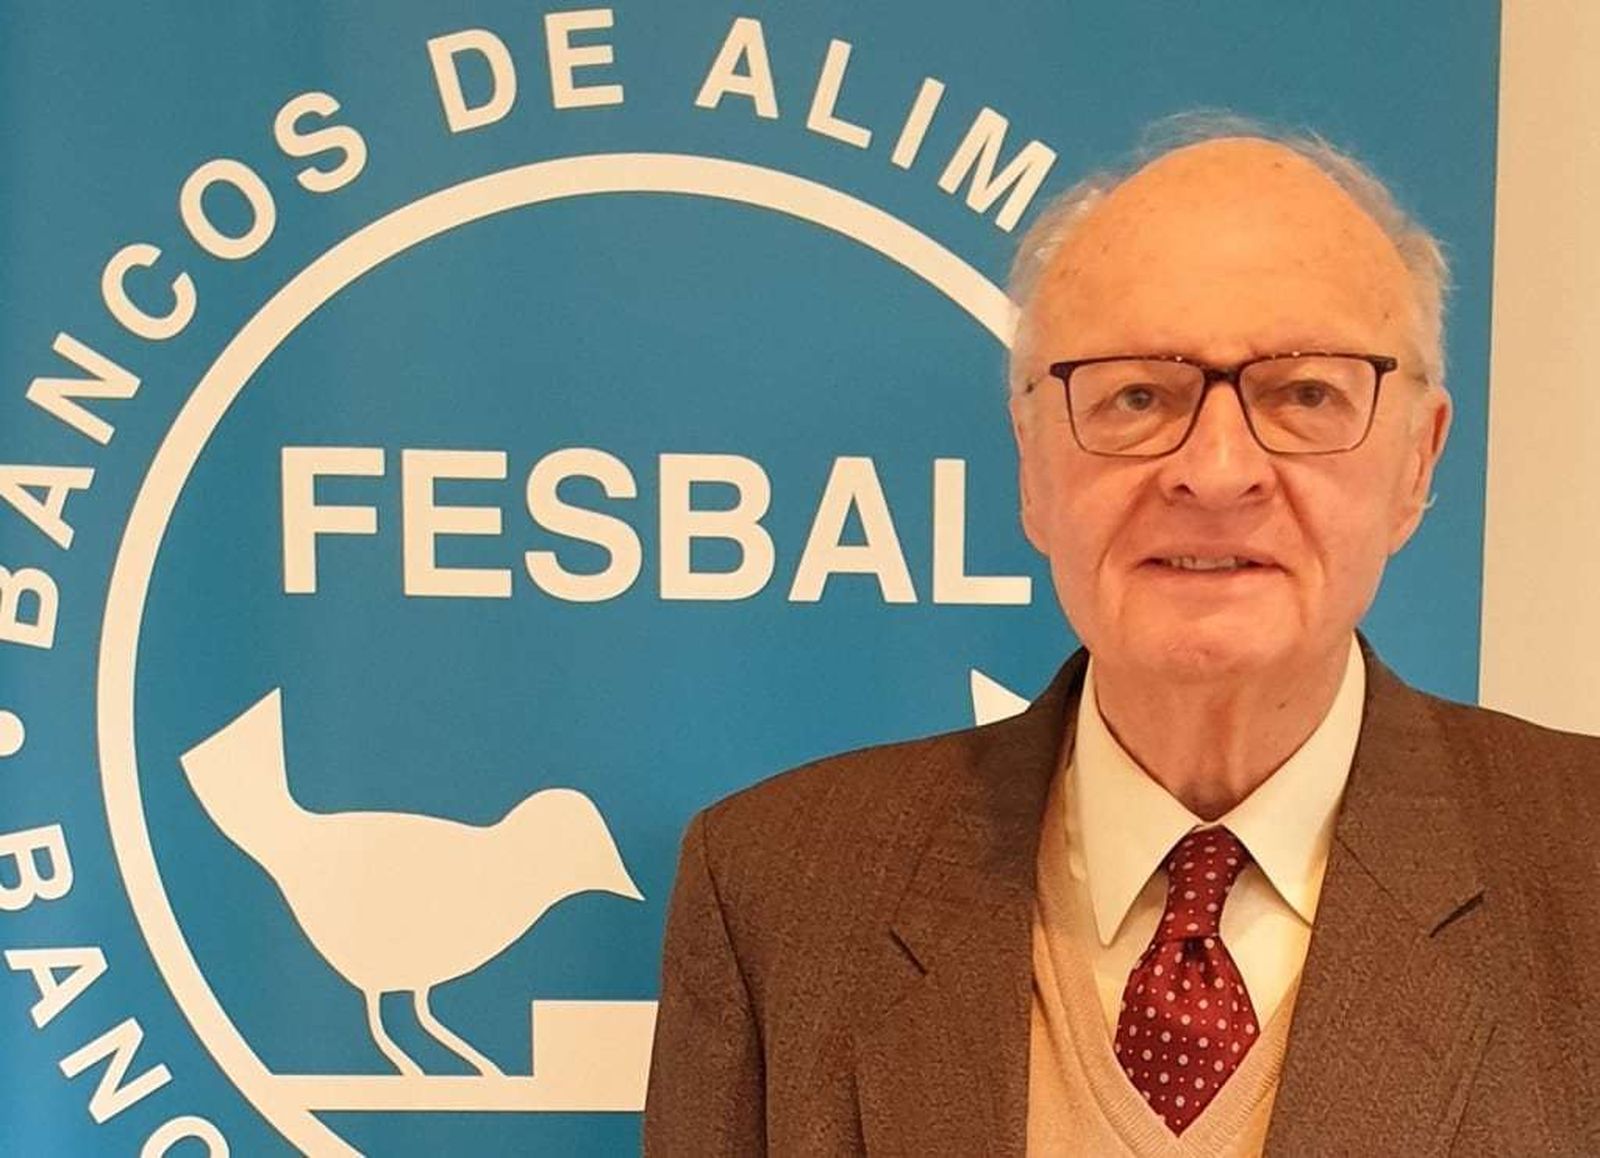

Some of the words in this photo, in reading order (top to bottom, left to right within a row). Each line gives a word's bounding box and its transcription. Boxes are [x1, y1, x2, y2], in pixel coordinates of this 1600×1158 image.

[0, 92, 367, 649] BANCOS
[427, 8, 624, 133] DE
[695, 17, 1057, 233] ALIM
[281, 446, 1032, 605] FESBAL
